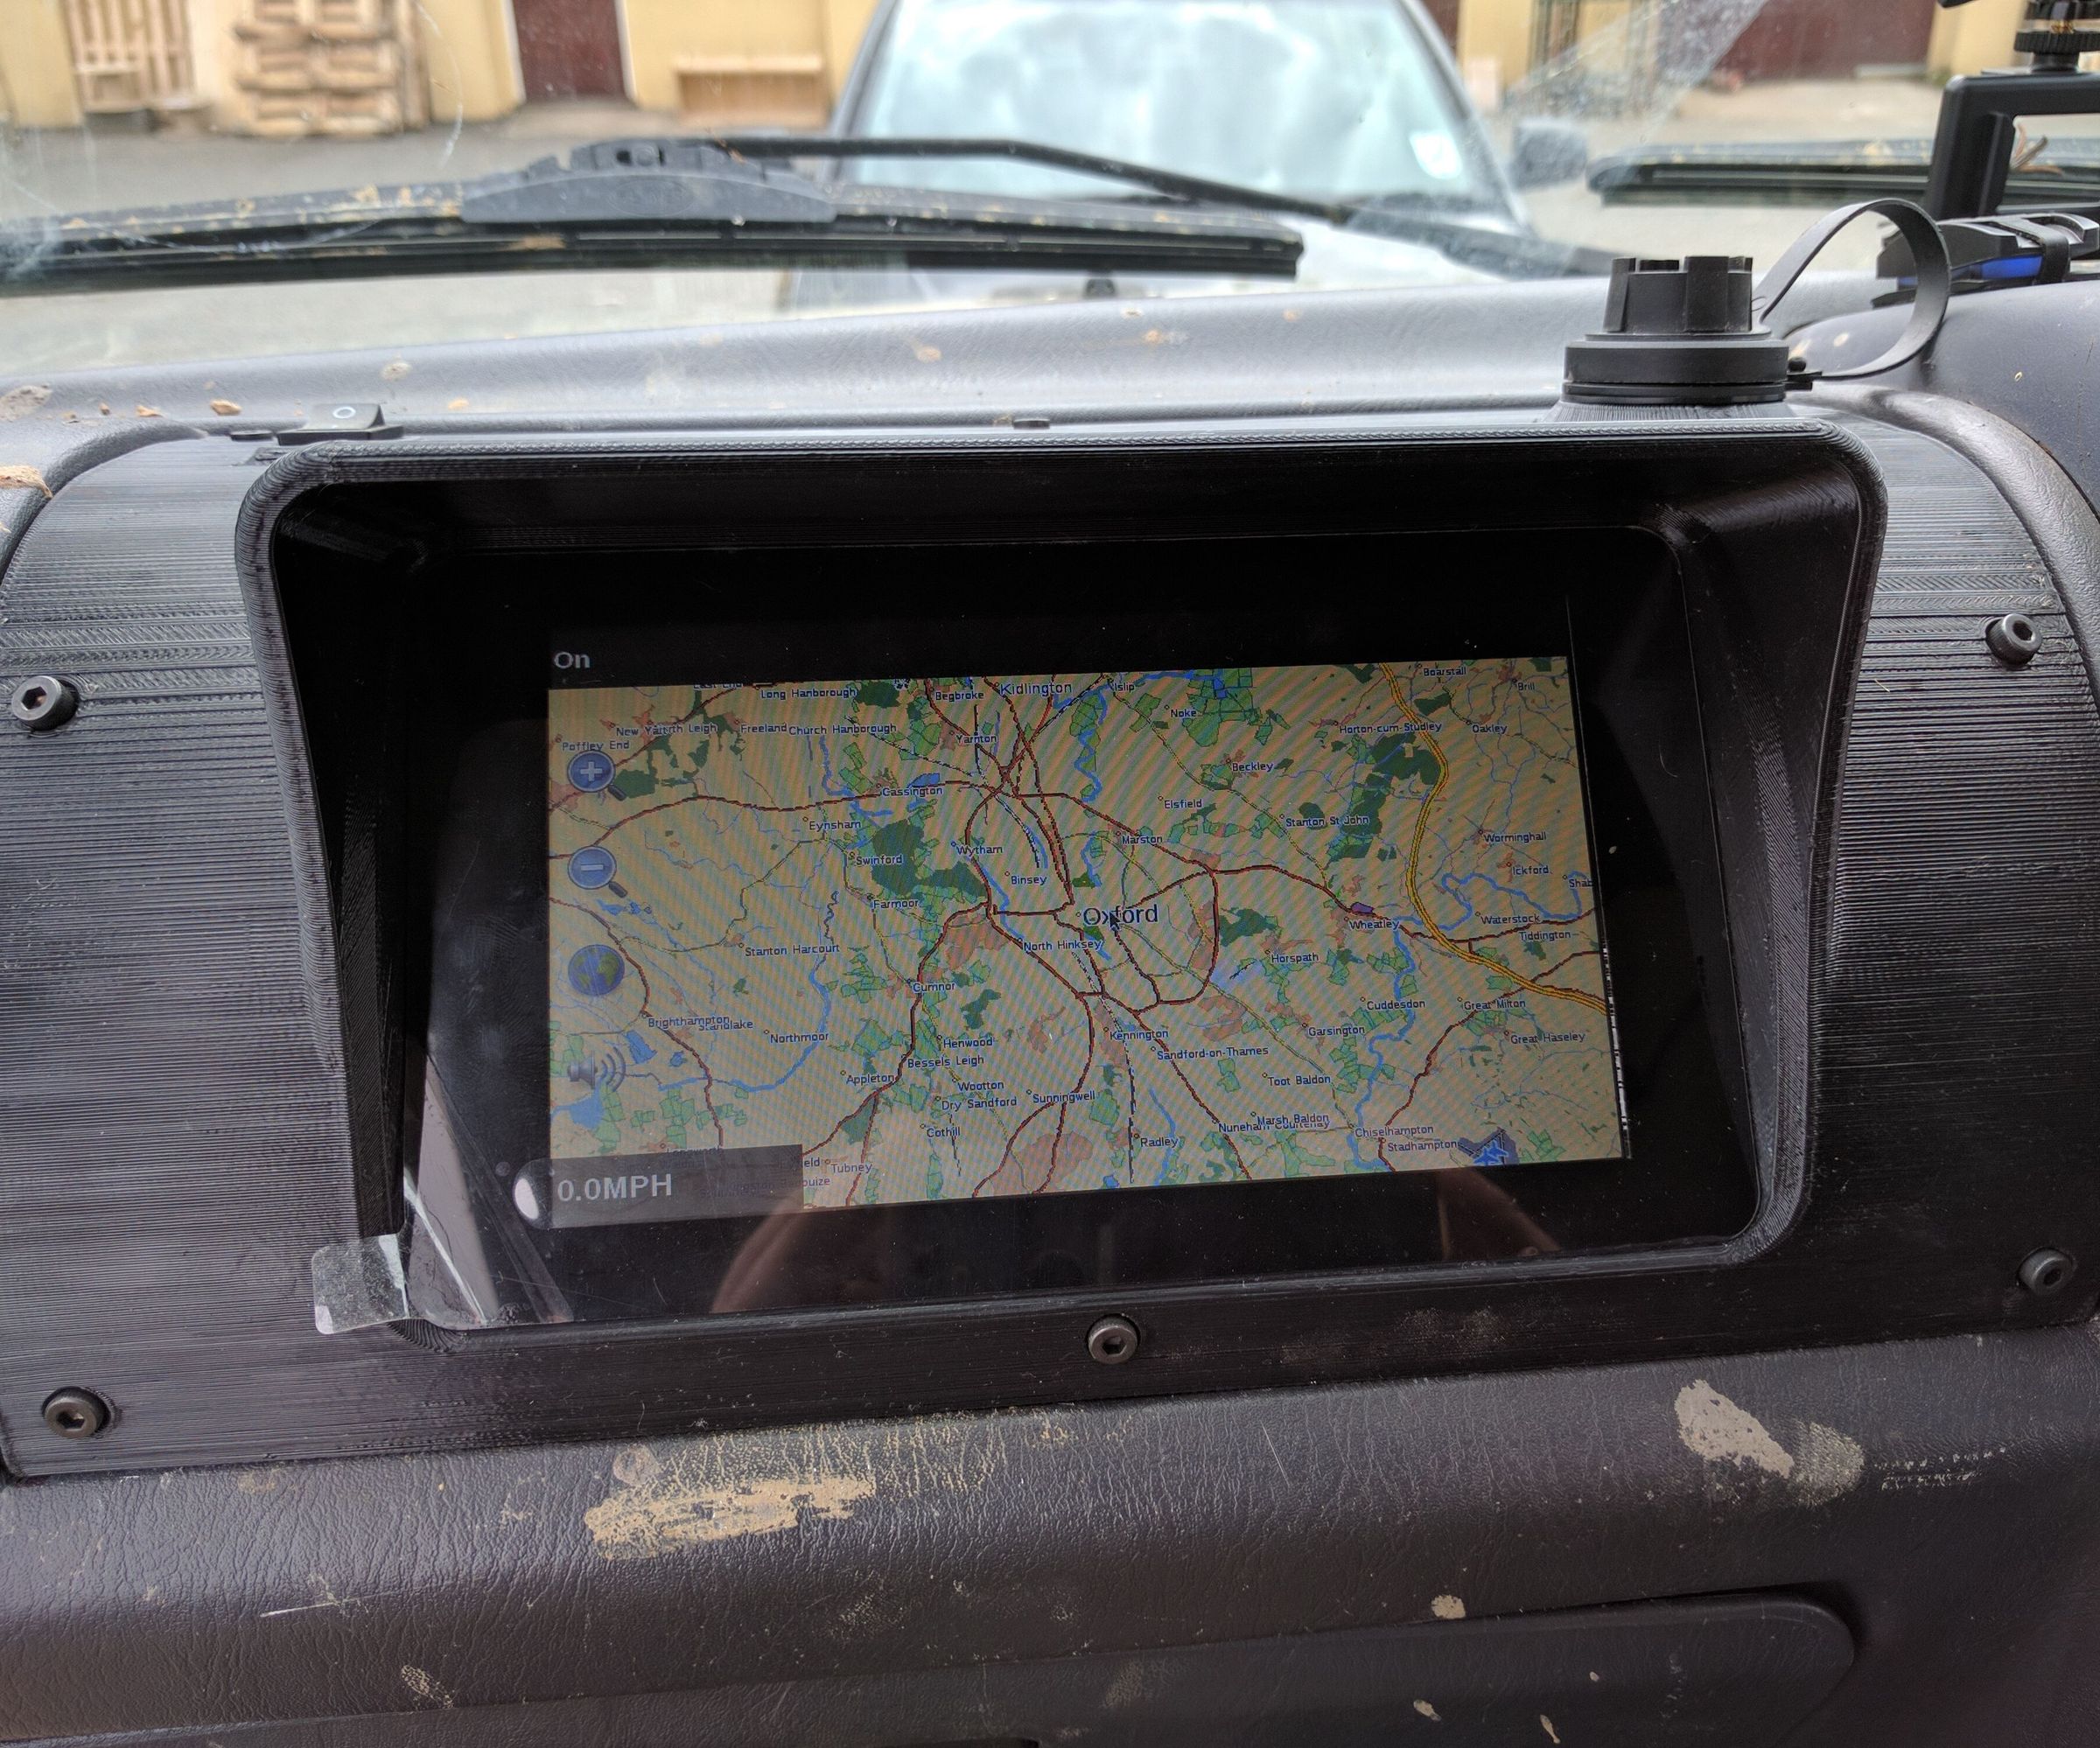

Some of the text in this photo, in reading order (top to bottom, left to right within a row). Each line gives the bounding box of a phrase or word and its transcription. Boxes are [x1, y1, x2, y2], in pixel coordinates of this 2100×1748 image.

[554, 652, 591, 669] On
[1001, 682, 1072, 698] Kidlington
[1115, 682, 1135, 694] Islip
[1518, 682, 1535, 691] Brill
[761, 688, 858, 700] Long Hanborough
[935, 690, 984, 703] Begbroke
[1171, 709, 1197, 718] Noke
[617, 727, 639, 737] New
[690, 722, 717, 735] Leigh
[741, 723, 788, 733] Freeland
[789, 724, 897, 737] Church Hanborough
[1473, 724, 1507, 735] Oakley
[610, 739, 631, 750] End
[956, 734, 998, 744] Yarnton
[1232, 762, 1274, 773] Beckley
[882, 787, 942, 799] Cassington
[1165, 799, 1202, 810] Elsfield
[809, 819, 861, 831] Eynsham
[1286, 815, 1369, 828] Stanton St John
[1123, 834, 1162, 845] Marston
[1484, 832, 1547, 846] Worminghall
[957, 844, 1003, 857] Wytham
[857, 855, 902, 866] Swinford
[1513, 864, 1549, 876] Ickford
[1012, 876, 1046, 887] Binsey
[874, 899, 918, 909] Farmoor
[1083, 904, 1158, 926] Oxford
[1480, 913, 1540, 925] Waterstock
[1349, 919, 1399, 930] Wheatley
[1520, 931, 1571, 942] Tiddington
[746, 944, 840, 956] Stanton Harcourt
[1024, 939, 1102, 951] North Hinksey
[1272, 953, 1319, 966] Horspath
[1367, 999, 1425, 1010] Cuddesdon
[1465, 999, 1526, 1010] Great Milton
[648, 1016, 729, 1029] Brighthampton
[1110, 1030, 1168, 1041] Kennington
[1308, 1024, 1365, 1037] Garsington
[771, 1032, 830, 1044] Northmoor
[943, 1038, 992, 1048] Henwood
[1511, 1032, 1585, 1045] Great Haseley
[908, 1055, 984, 1068] Bessels Leigh
[846, 1073, 894, 1085] Appleton
[1269, 1075, 1331, 1087] Toot Baldon
[958, 1081, 1004, 1092] Wootton
[1032, 1092, 1095, 1103] Sunningwell
[942, 1097, 1017, 1111] Dry Sandford
[1257, 1113, 1329, 1126] Marsh Baldon
[927, 1127, 961, 1137] Cothill
[1355, 1125, 1434, 1137] Chiselhampton
[1141, 1137, 1178, 1149] Radley
[1388, 1141, 1457, 1152] Stadhampton
[831, 1163, 872, 1174] Tubney
[557, 1173, 672, 1202] 0.0MPH
